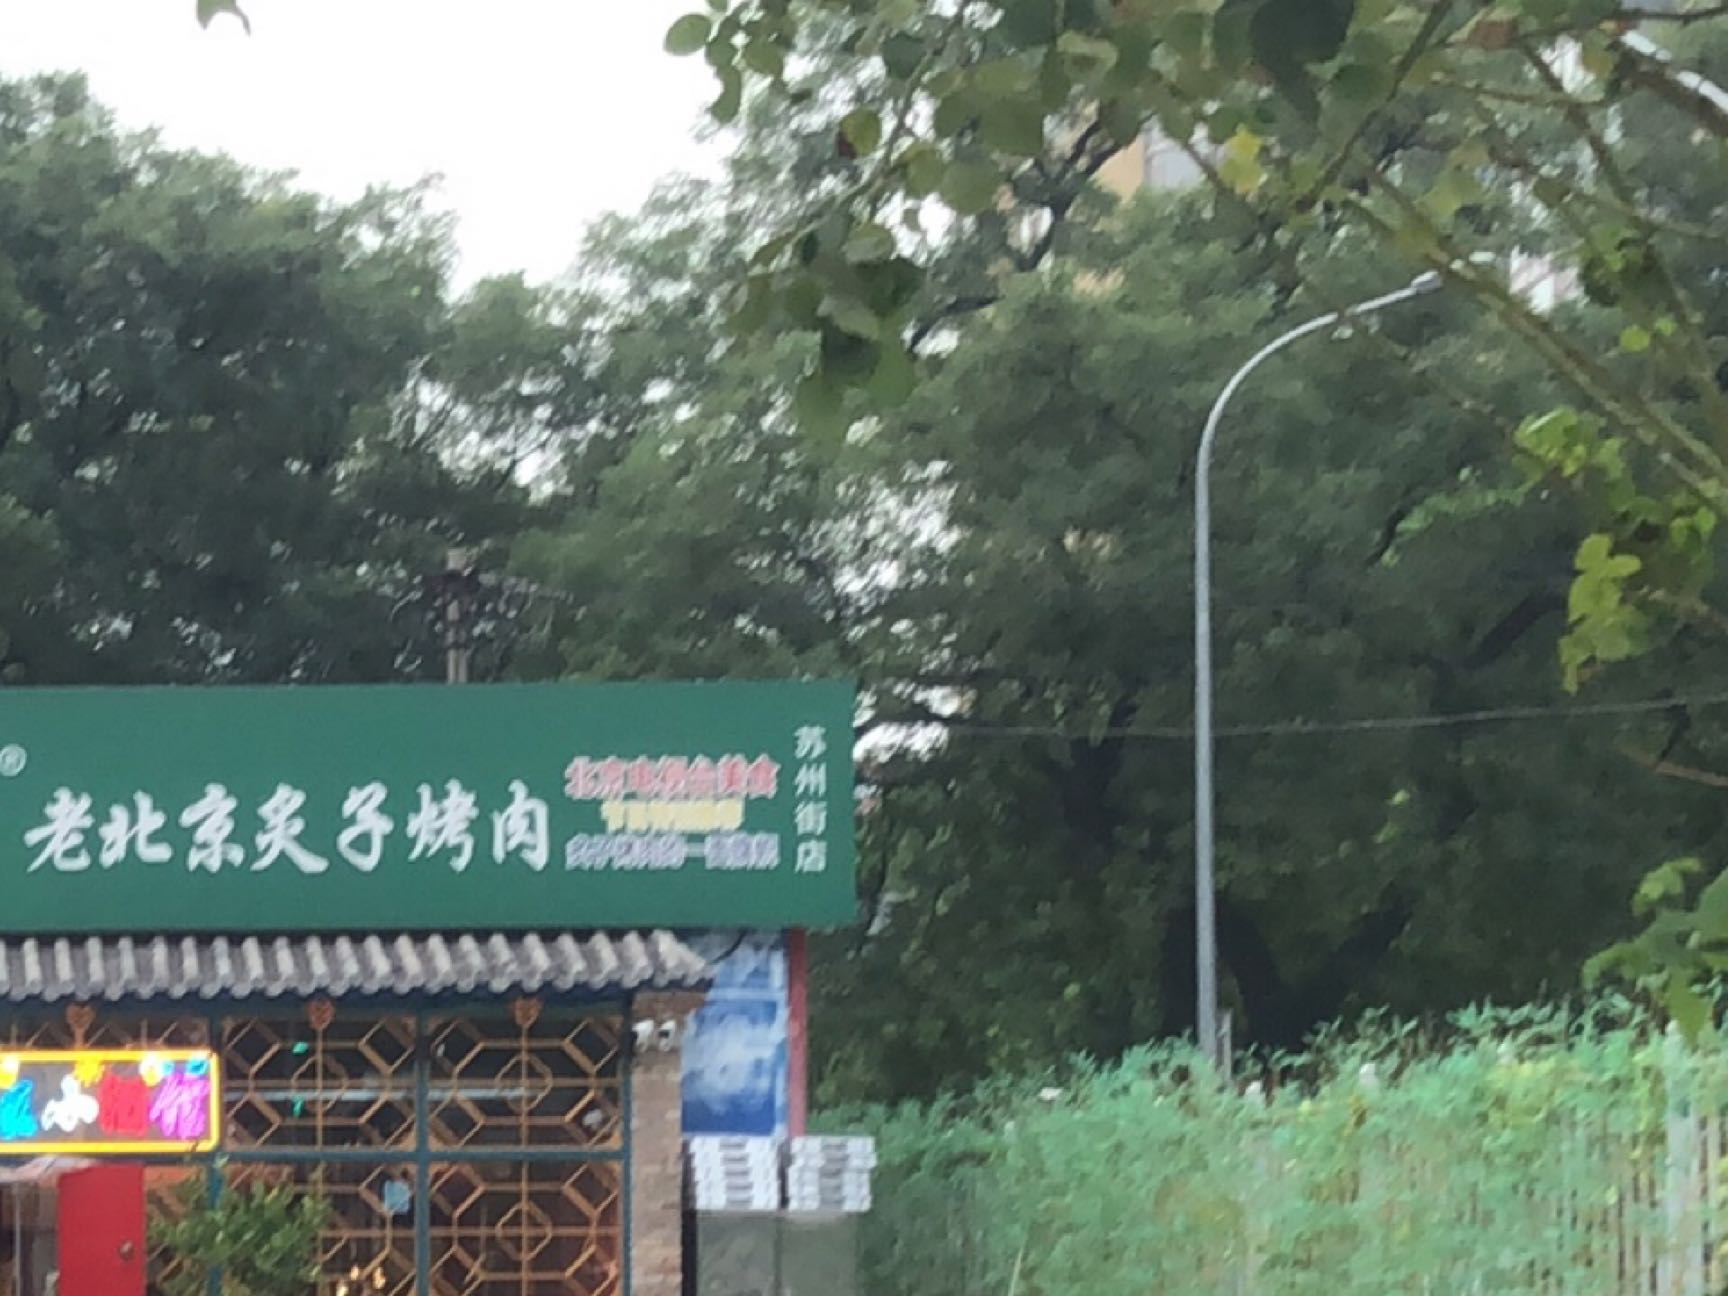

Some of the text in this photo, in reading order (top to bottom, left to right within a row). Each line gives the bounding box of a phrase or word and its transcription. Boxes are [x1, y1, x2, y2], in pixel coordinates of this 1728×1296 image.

[24, 779, 549, 872] 老北京炙子烤肉
[795, 725, 827, 872] 苏州街店
